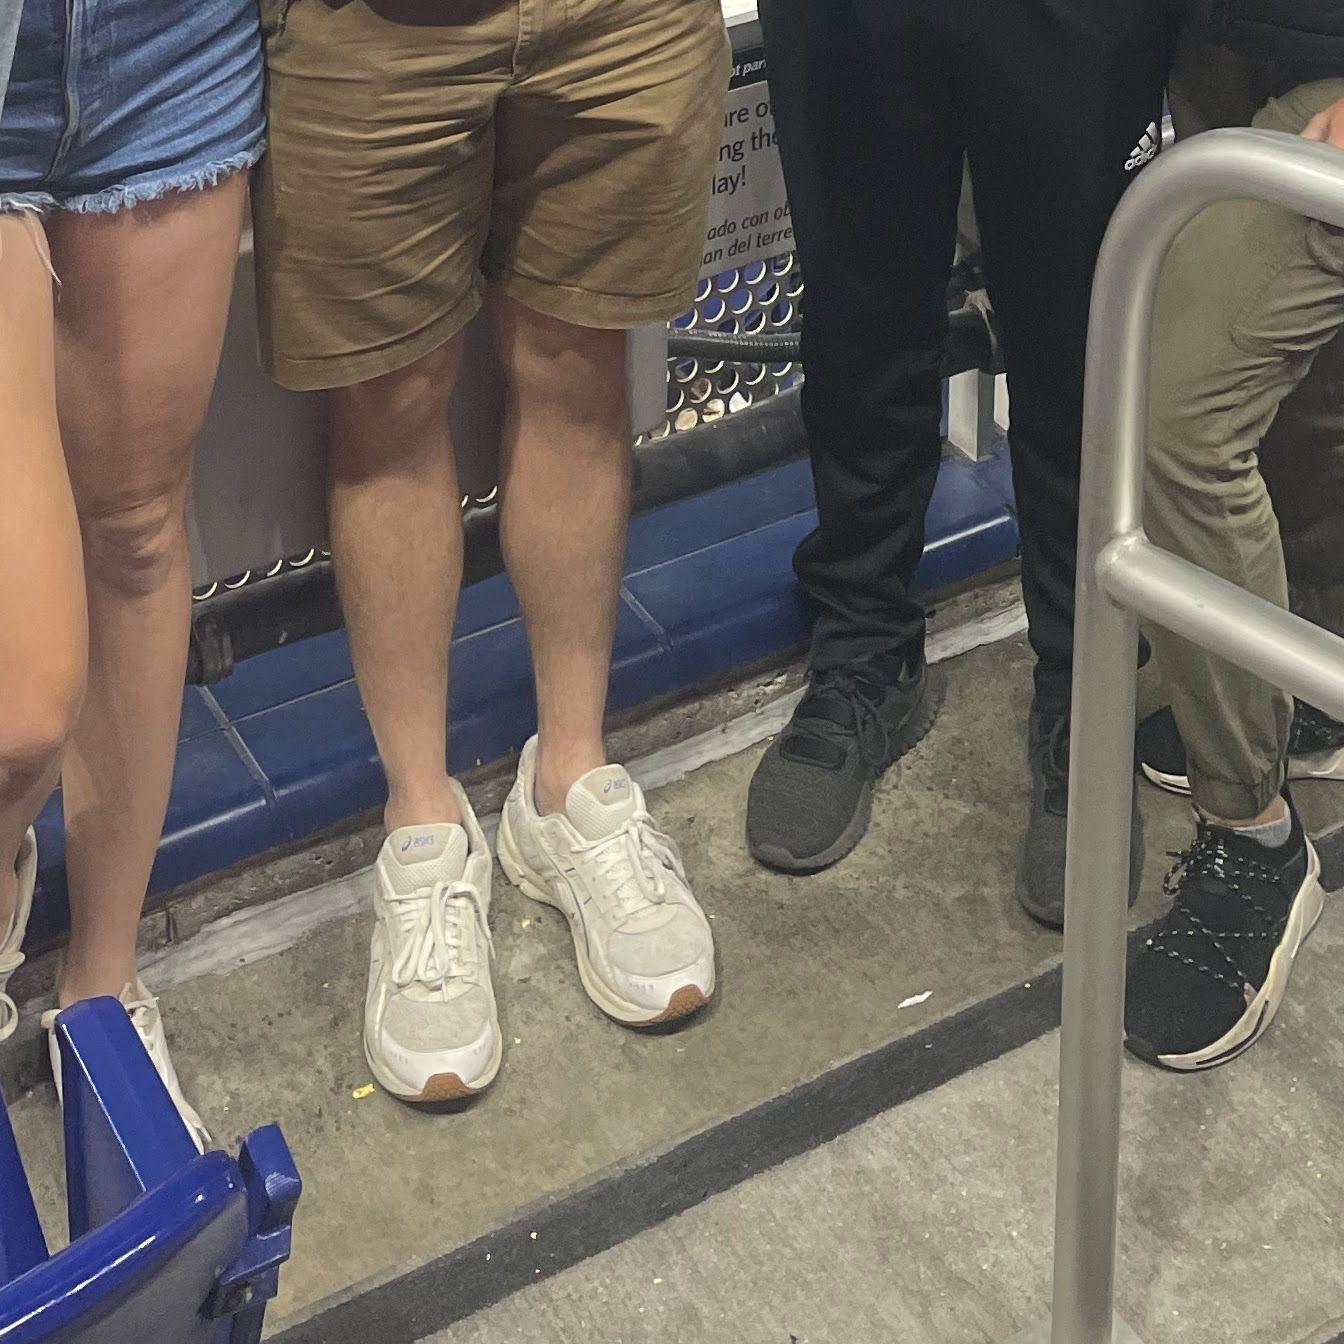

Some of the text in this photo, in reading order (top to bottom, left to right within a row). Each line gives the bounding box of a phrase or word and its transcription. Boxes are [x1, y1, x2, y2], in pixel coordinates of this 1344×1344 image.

[719, 140, 745, 162] ng
[712, 165, 746, 195] lay!
[707, 219, 737, 241] ado
[741, 210, 769, 230] con
[700, 226, 792, 265] an del terre
